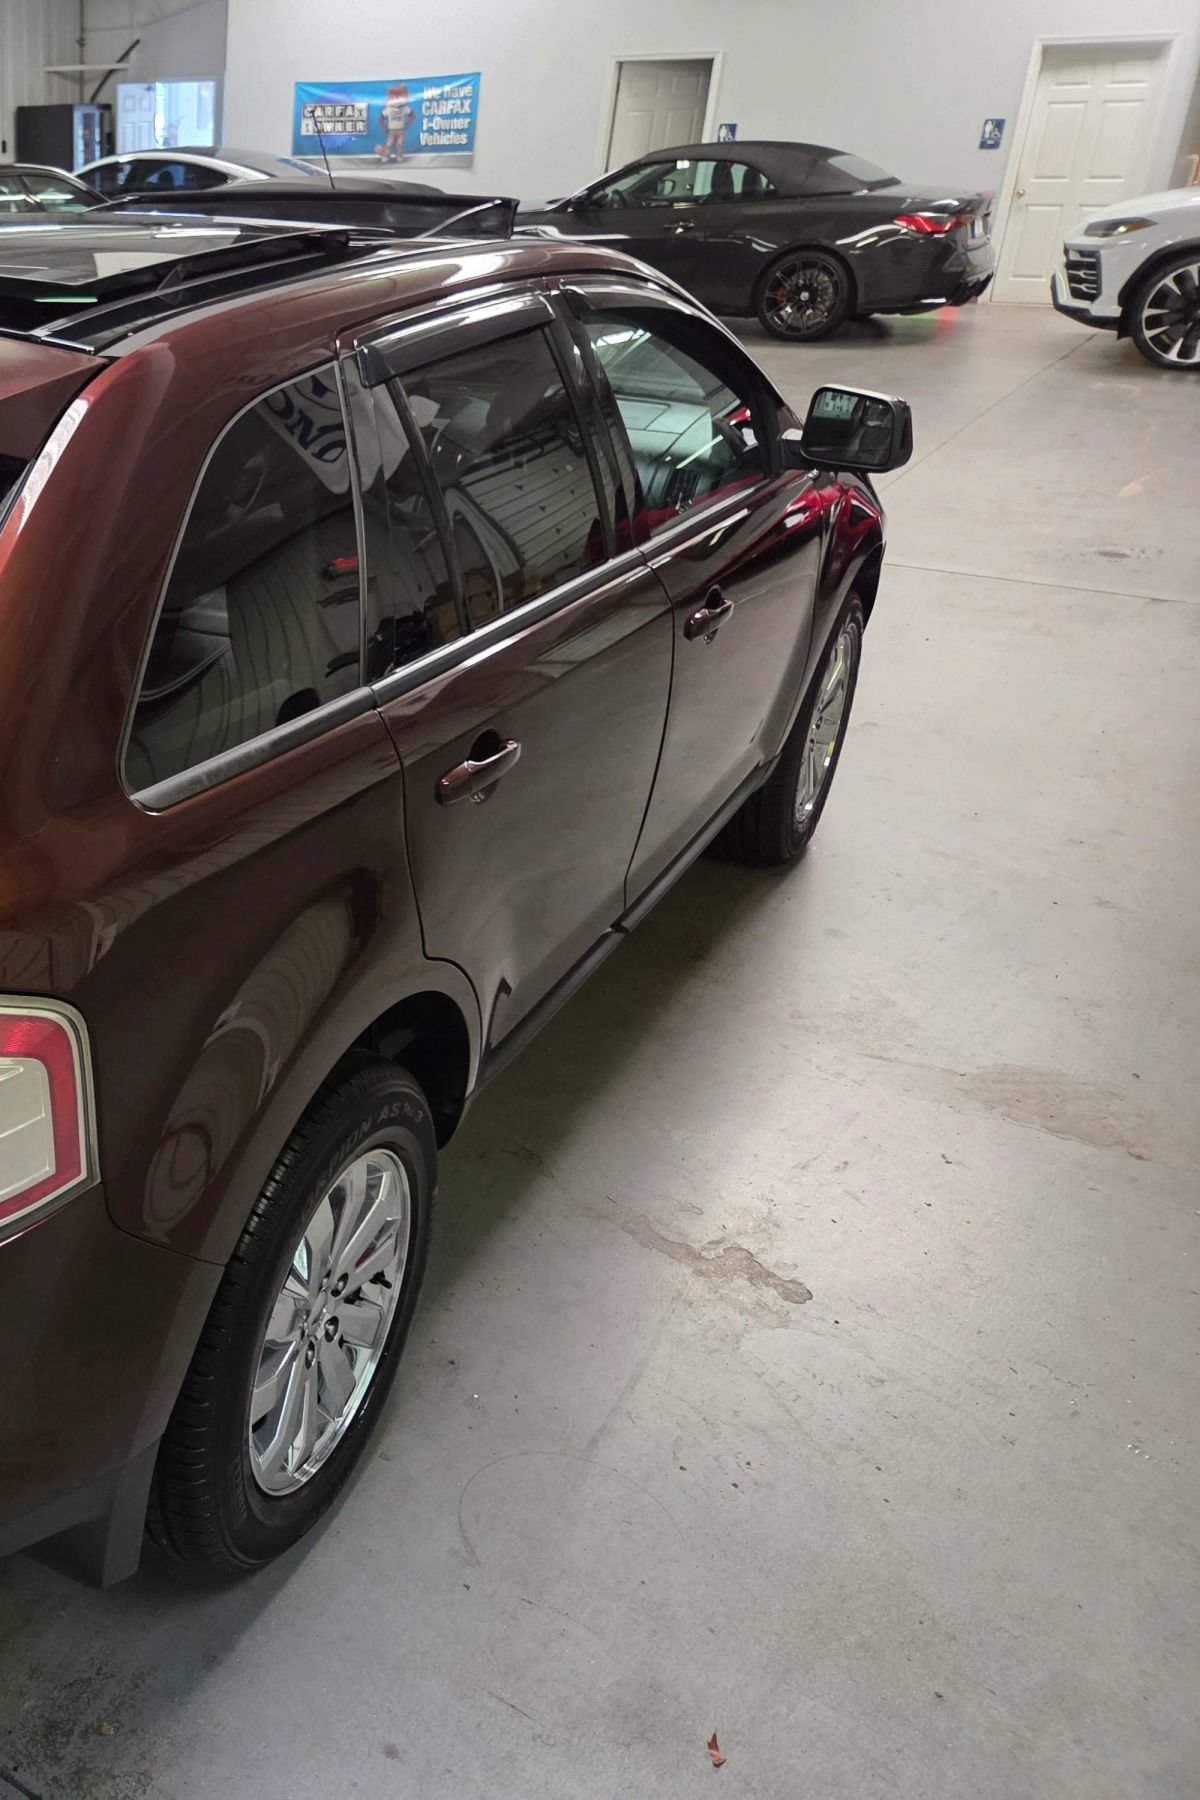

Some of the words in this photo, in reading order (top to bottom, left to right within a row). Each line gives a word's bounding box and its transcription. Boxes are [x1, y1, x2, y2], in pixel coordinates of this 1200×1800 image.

[423, 87, 441, 99] We
[444, 85, 472, 98] have
[303, 104, 367, 118] CARFAX
[422, 99, 471, 116] CARFAX
[423, 117, 470, 130] 1-Owner
[420, 131, 467, 145] Vehicles
